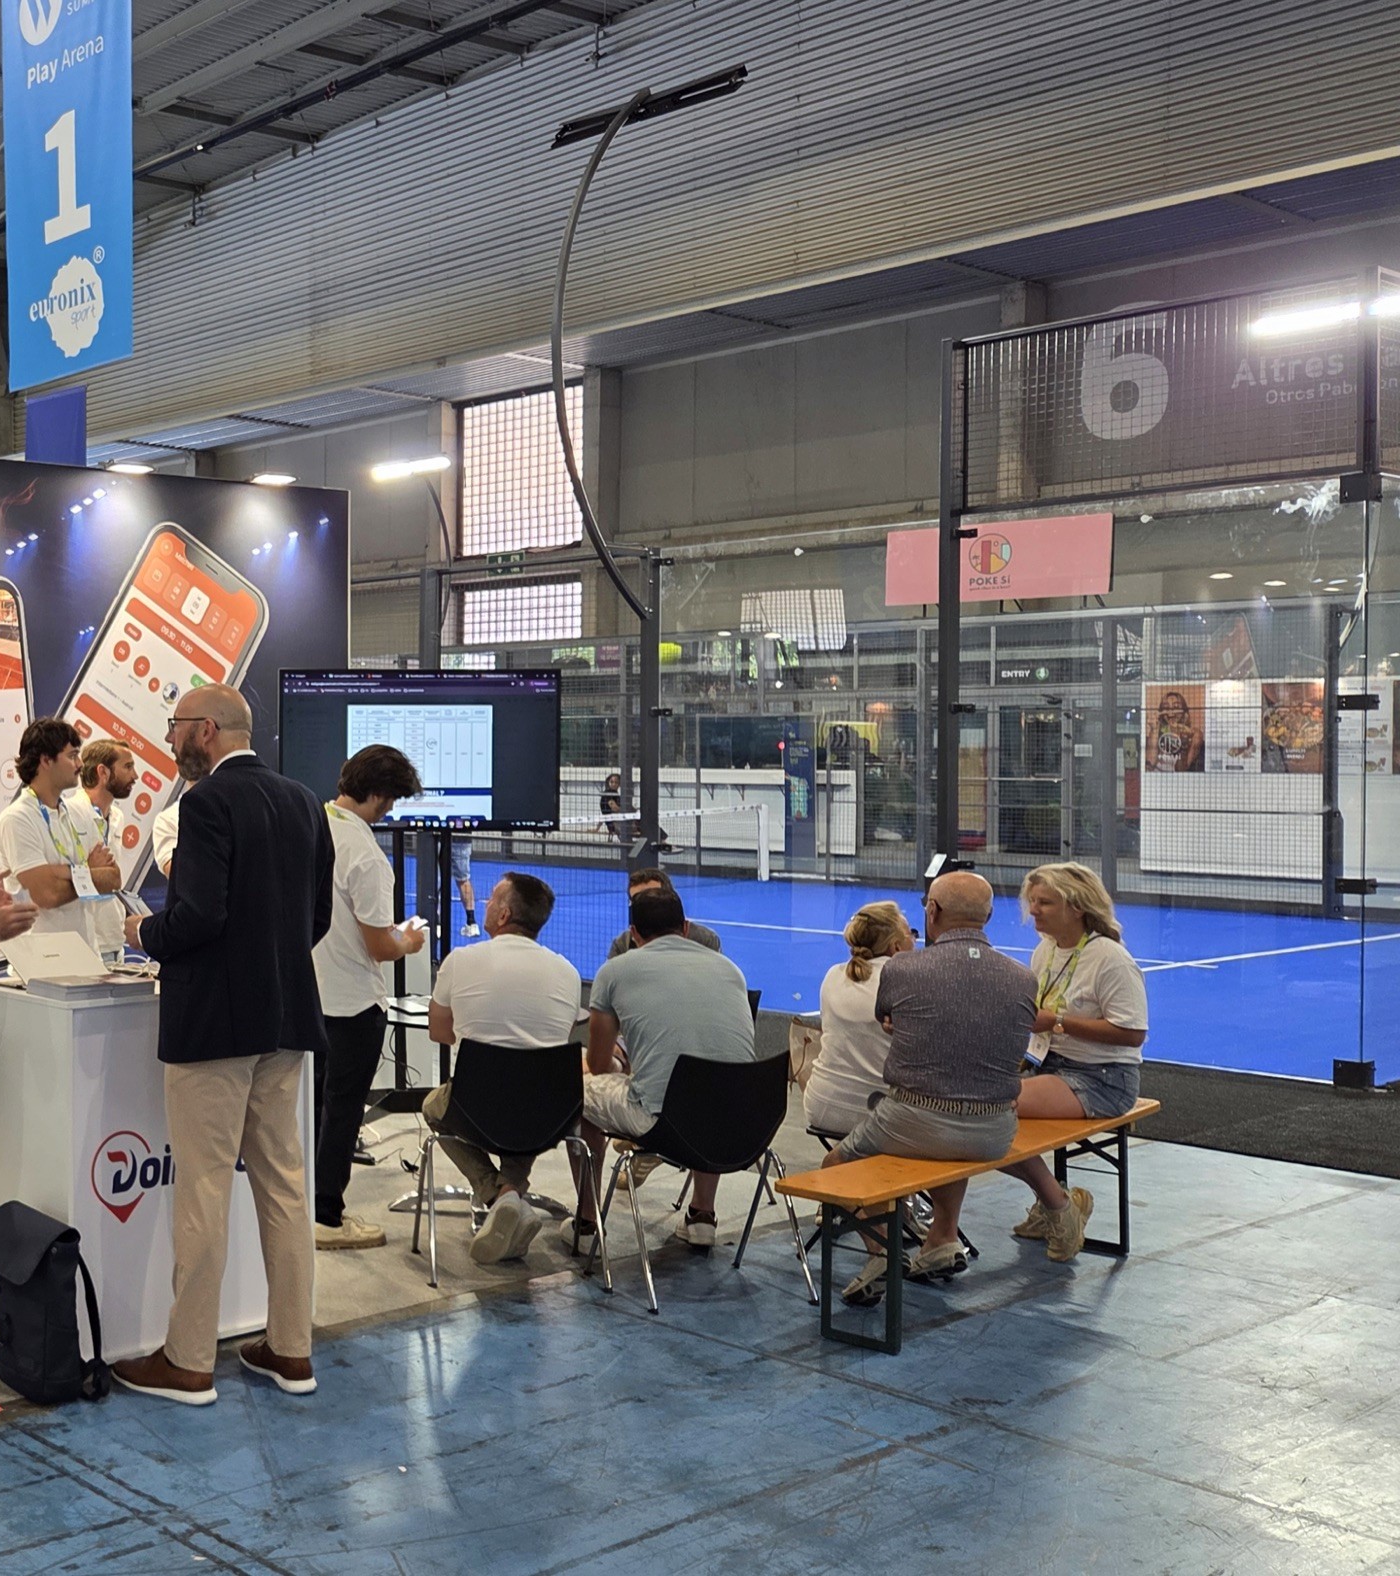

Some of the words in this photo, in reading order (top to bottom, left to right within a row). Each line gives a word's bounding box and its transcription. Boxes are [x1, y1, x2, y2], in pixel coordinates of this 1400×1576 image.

[27, 58, 58, 90] Play
[61, 35, 104, 72] Arena
[44, 109, 91, 245] 1
[29, 278, 96, 322] euronix
[70, 305, 96, 330] sport
[1081, 302, 1169, 440] 6
[1231, 353, 1344, 389] Altres
[1266, 387, 1315, 404] Otros
[969, 576, 998, 586] POKE
[1001, 669, 1030, 678] ENTRY
